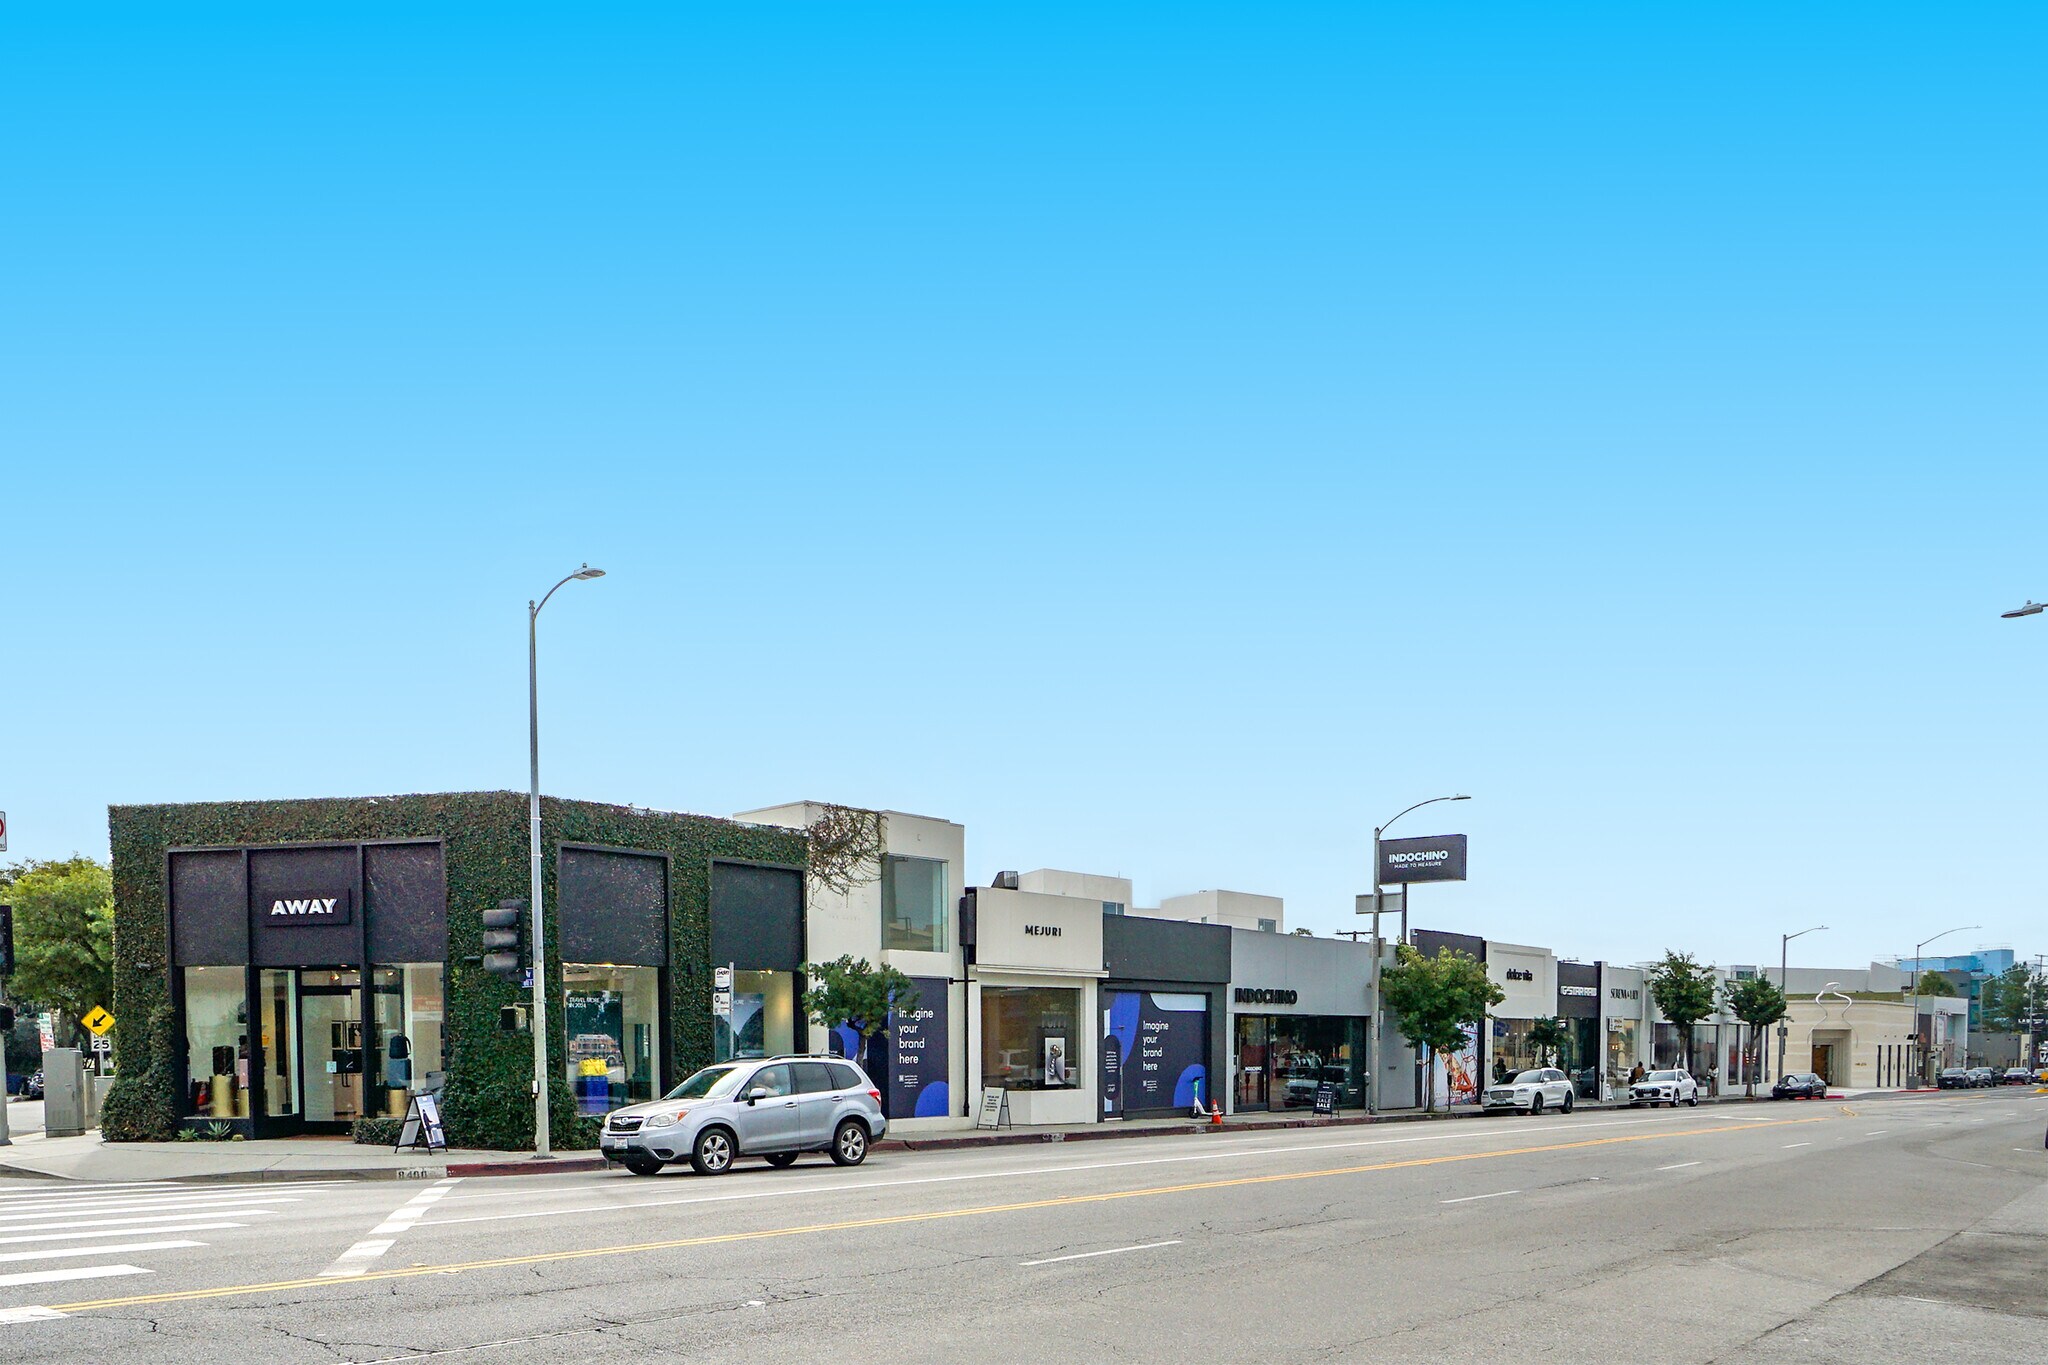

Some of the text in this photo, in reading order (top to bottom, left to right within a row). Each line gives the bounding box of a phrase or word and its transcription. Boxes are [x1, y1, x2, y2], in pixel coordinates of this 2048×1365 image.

[1389, 850, 1449, 863] INDOCHINO
[271, 898, 338, 915] AWAY
[1025, 925, 1062, 937] MEJURI
[1235, 988, 1298, 1005] INDOCHINO
[899, 1025, 918, 1036] your
[1143, 1020, 1169, 1033] Imagine
[93, 1040, 110, 1049] 25
[899, 1037, 925, 1048] brand
[1143, 1036, 1158, 1046] your
[1143, 1047, 1162, 1057] brand
[899, 1053, 919, 1064] here
[1143, 1061, 1158, 1071] here
